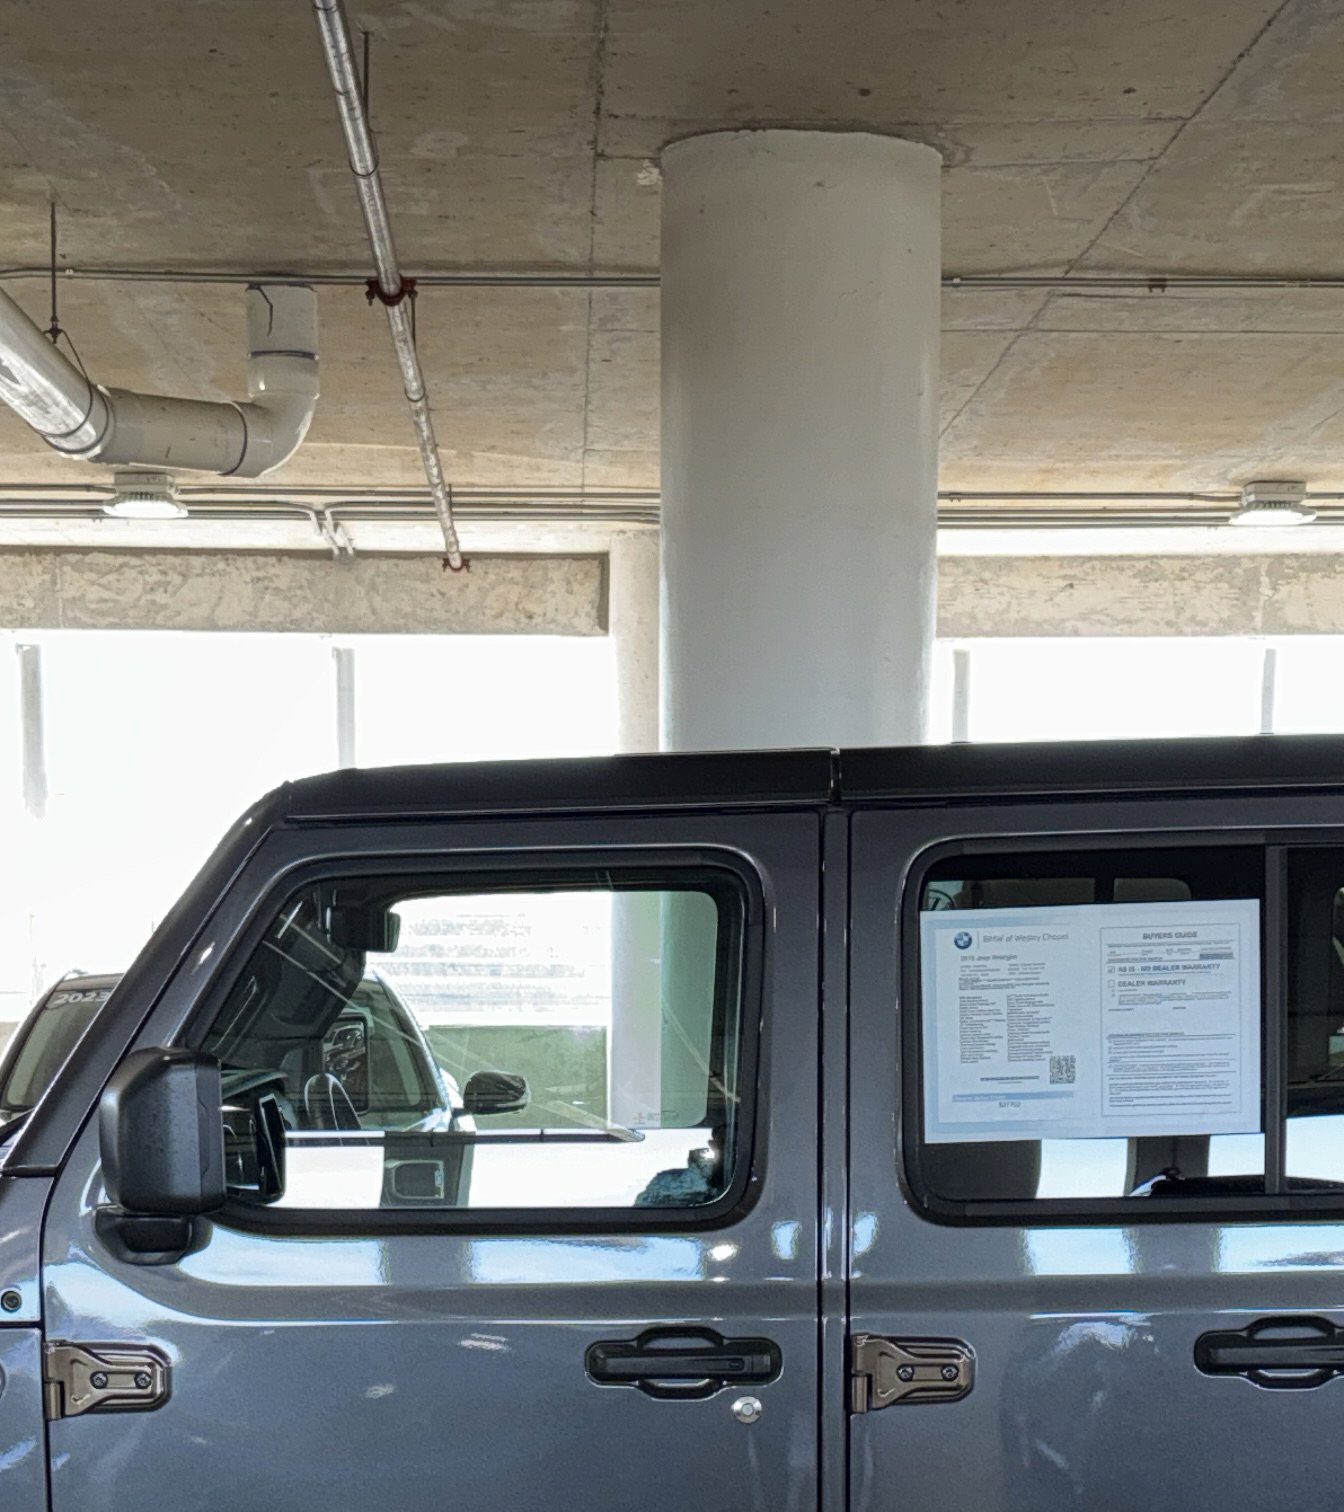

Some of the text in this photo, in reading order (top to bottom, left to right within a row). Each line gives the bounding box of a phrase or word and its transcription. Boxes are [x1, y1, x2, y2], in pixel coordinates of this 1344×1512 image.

[1142, 930, 1198, 940] BUYERS GUIDE
[1152, 964, 1180, 972] DEALER
[1181, 963, 1221, 971] WARRANTY
[1117, 979, 1186, 988] DEALER WARRANTY
